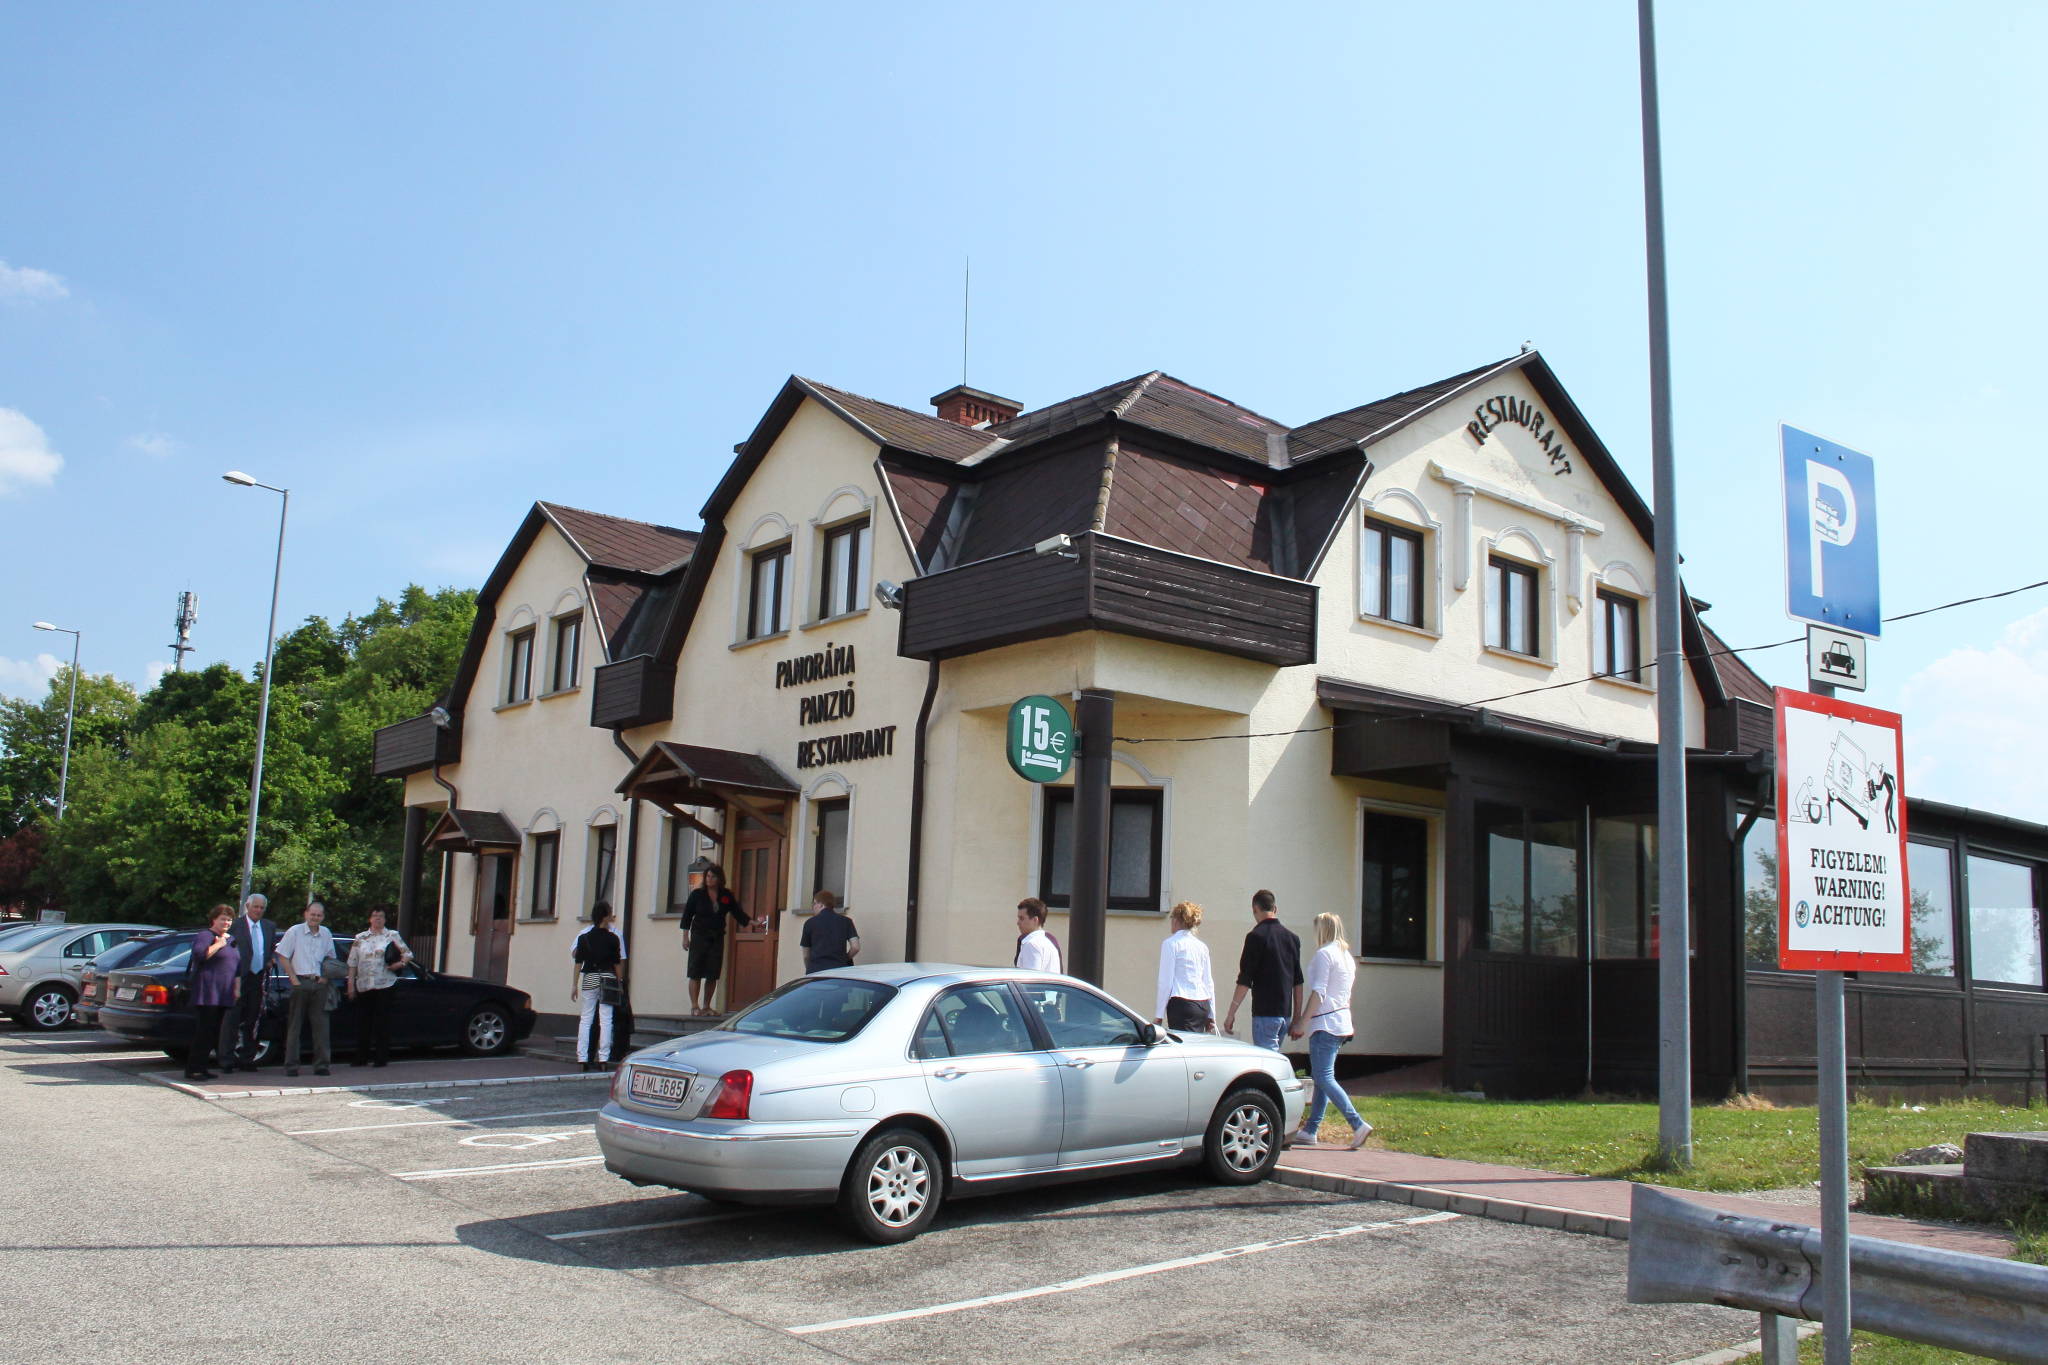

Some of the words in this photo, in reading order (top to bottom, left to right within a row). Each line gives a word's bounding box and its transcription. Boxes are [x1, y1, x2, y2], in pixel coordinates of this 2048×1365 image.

[1466, 395, 1572, 476] RESTAURANT
[1806, 458, 1856, 598] P
[775, 642, 856, 689] PANORÁMA
[800, 681, 855, 726] PANZIÓ
[797, 725, 897, 769] RESTAURANT
[1810, 848, 1887, 875] FIGYELEM!
[1814, 876, 1885, 901] WARNING!
[1812, 904, 1886, 928] ACHTUNG!
